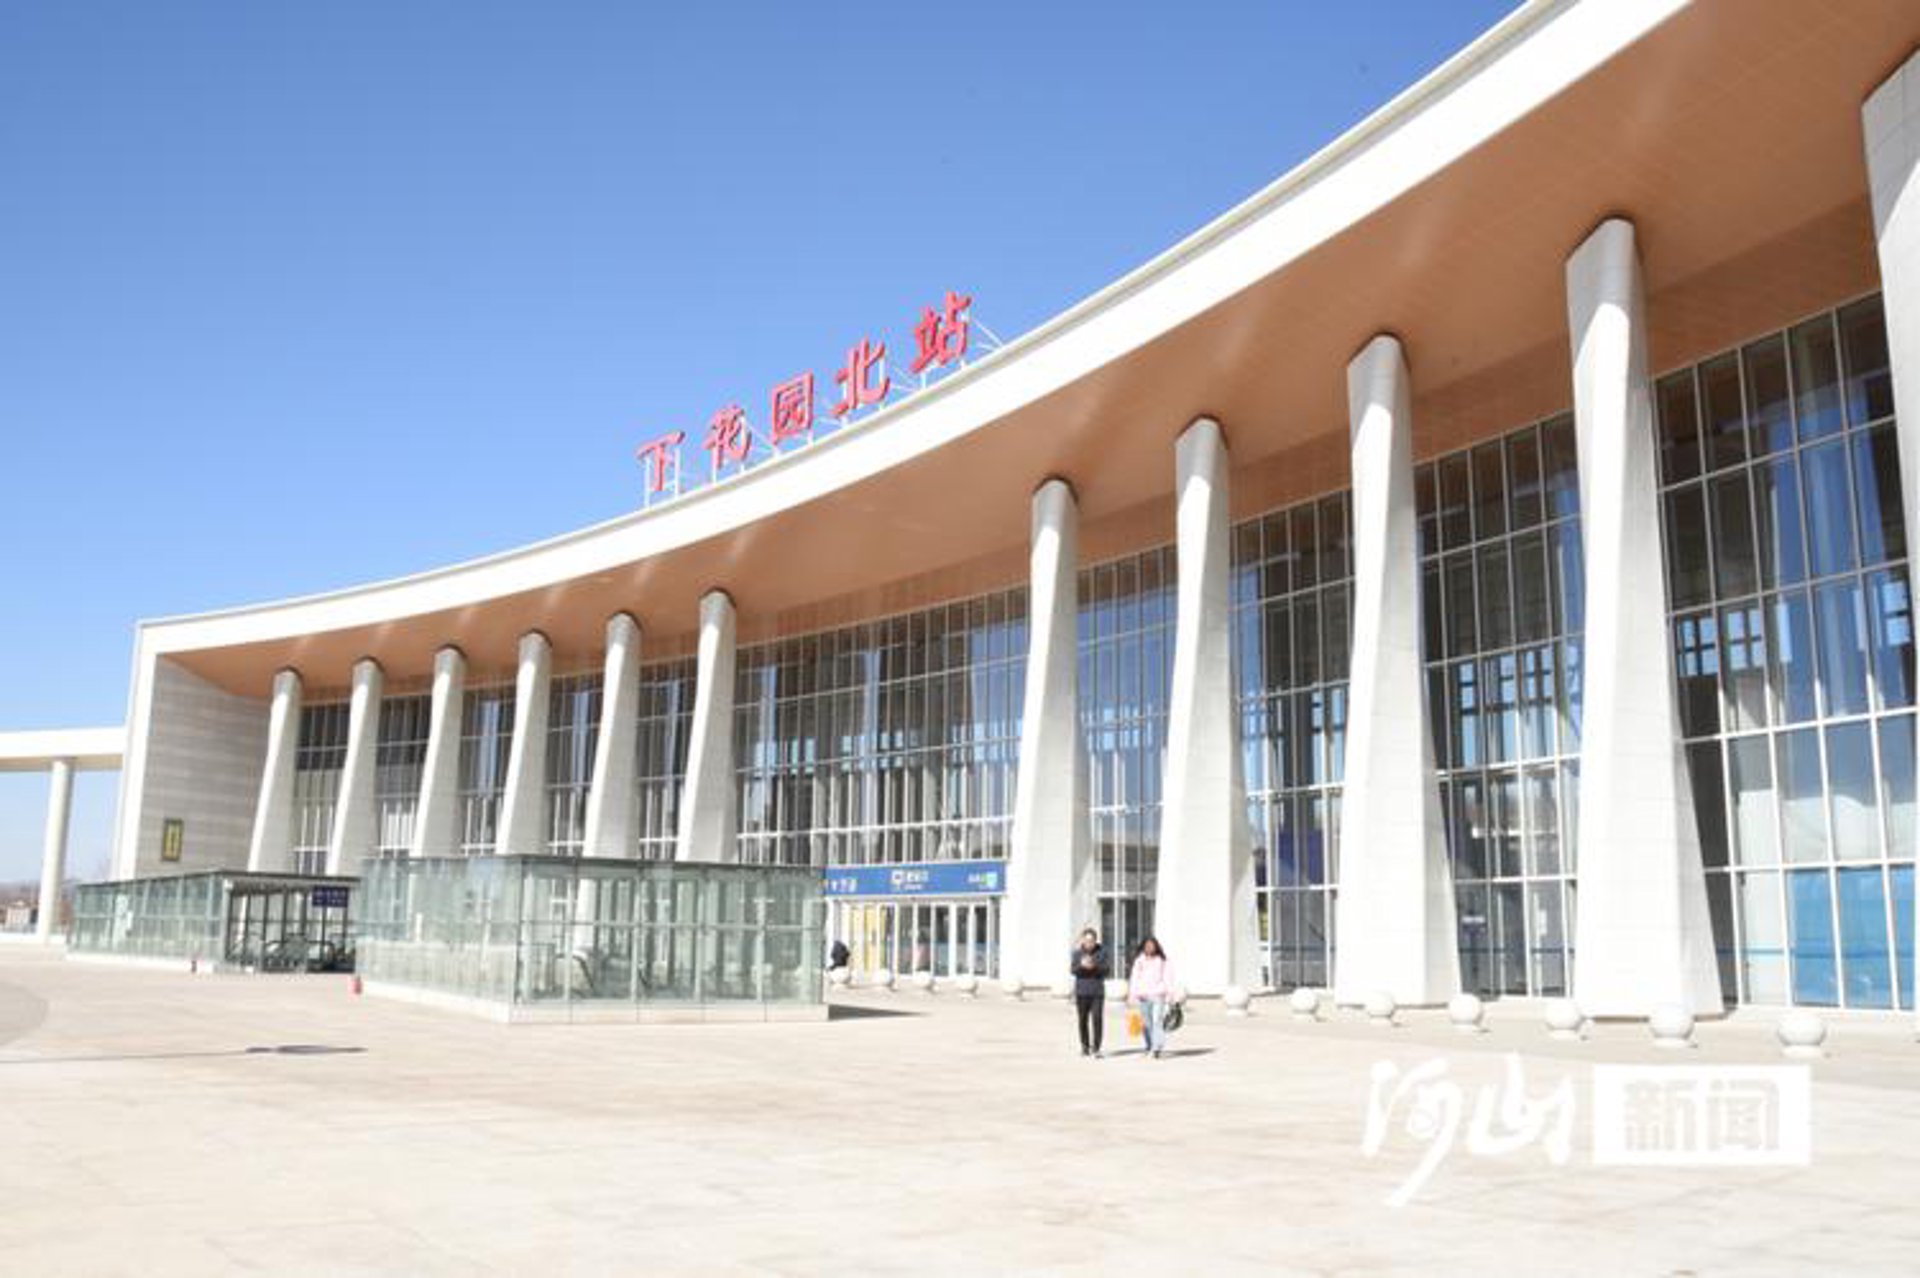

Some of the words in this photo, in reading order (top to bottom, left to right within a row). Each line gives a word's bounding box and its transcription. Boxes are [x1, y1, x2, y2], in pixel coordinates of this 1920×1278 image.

[636, 291, 972, 492] 下花园北站
